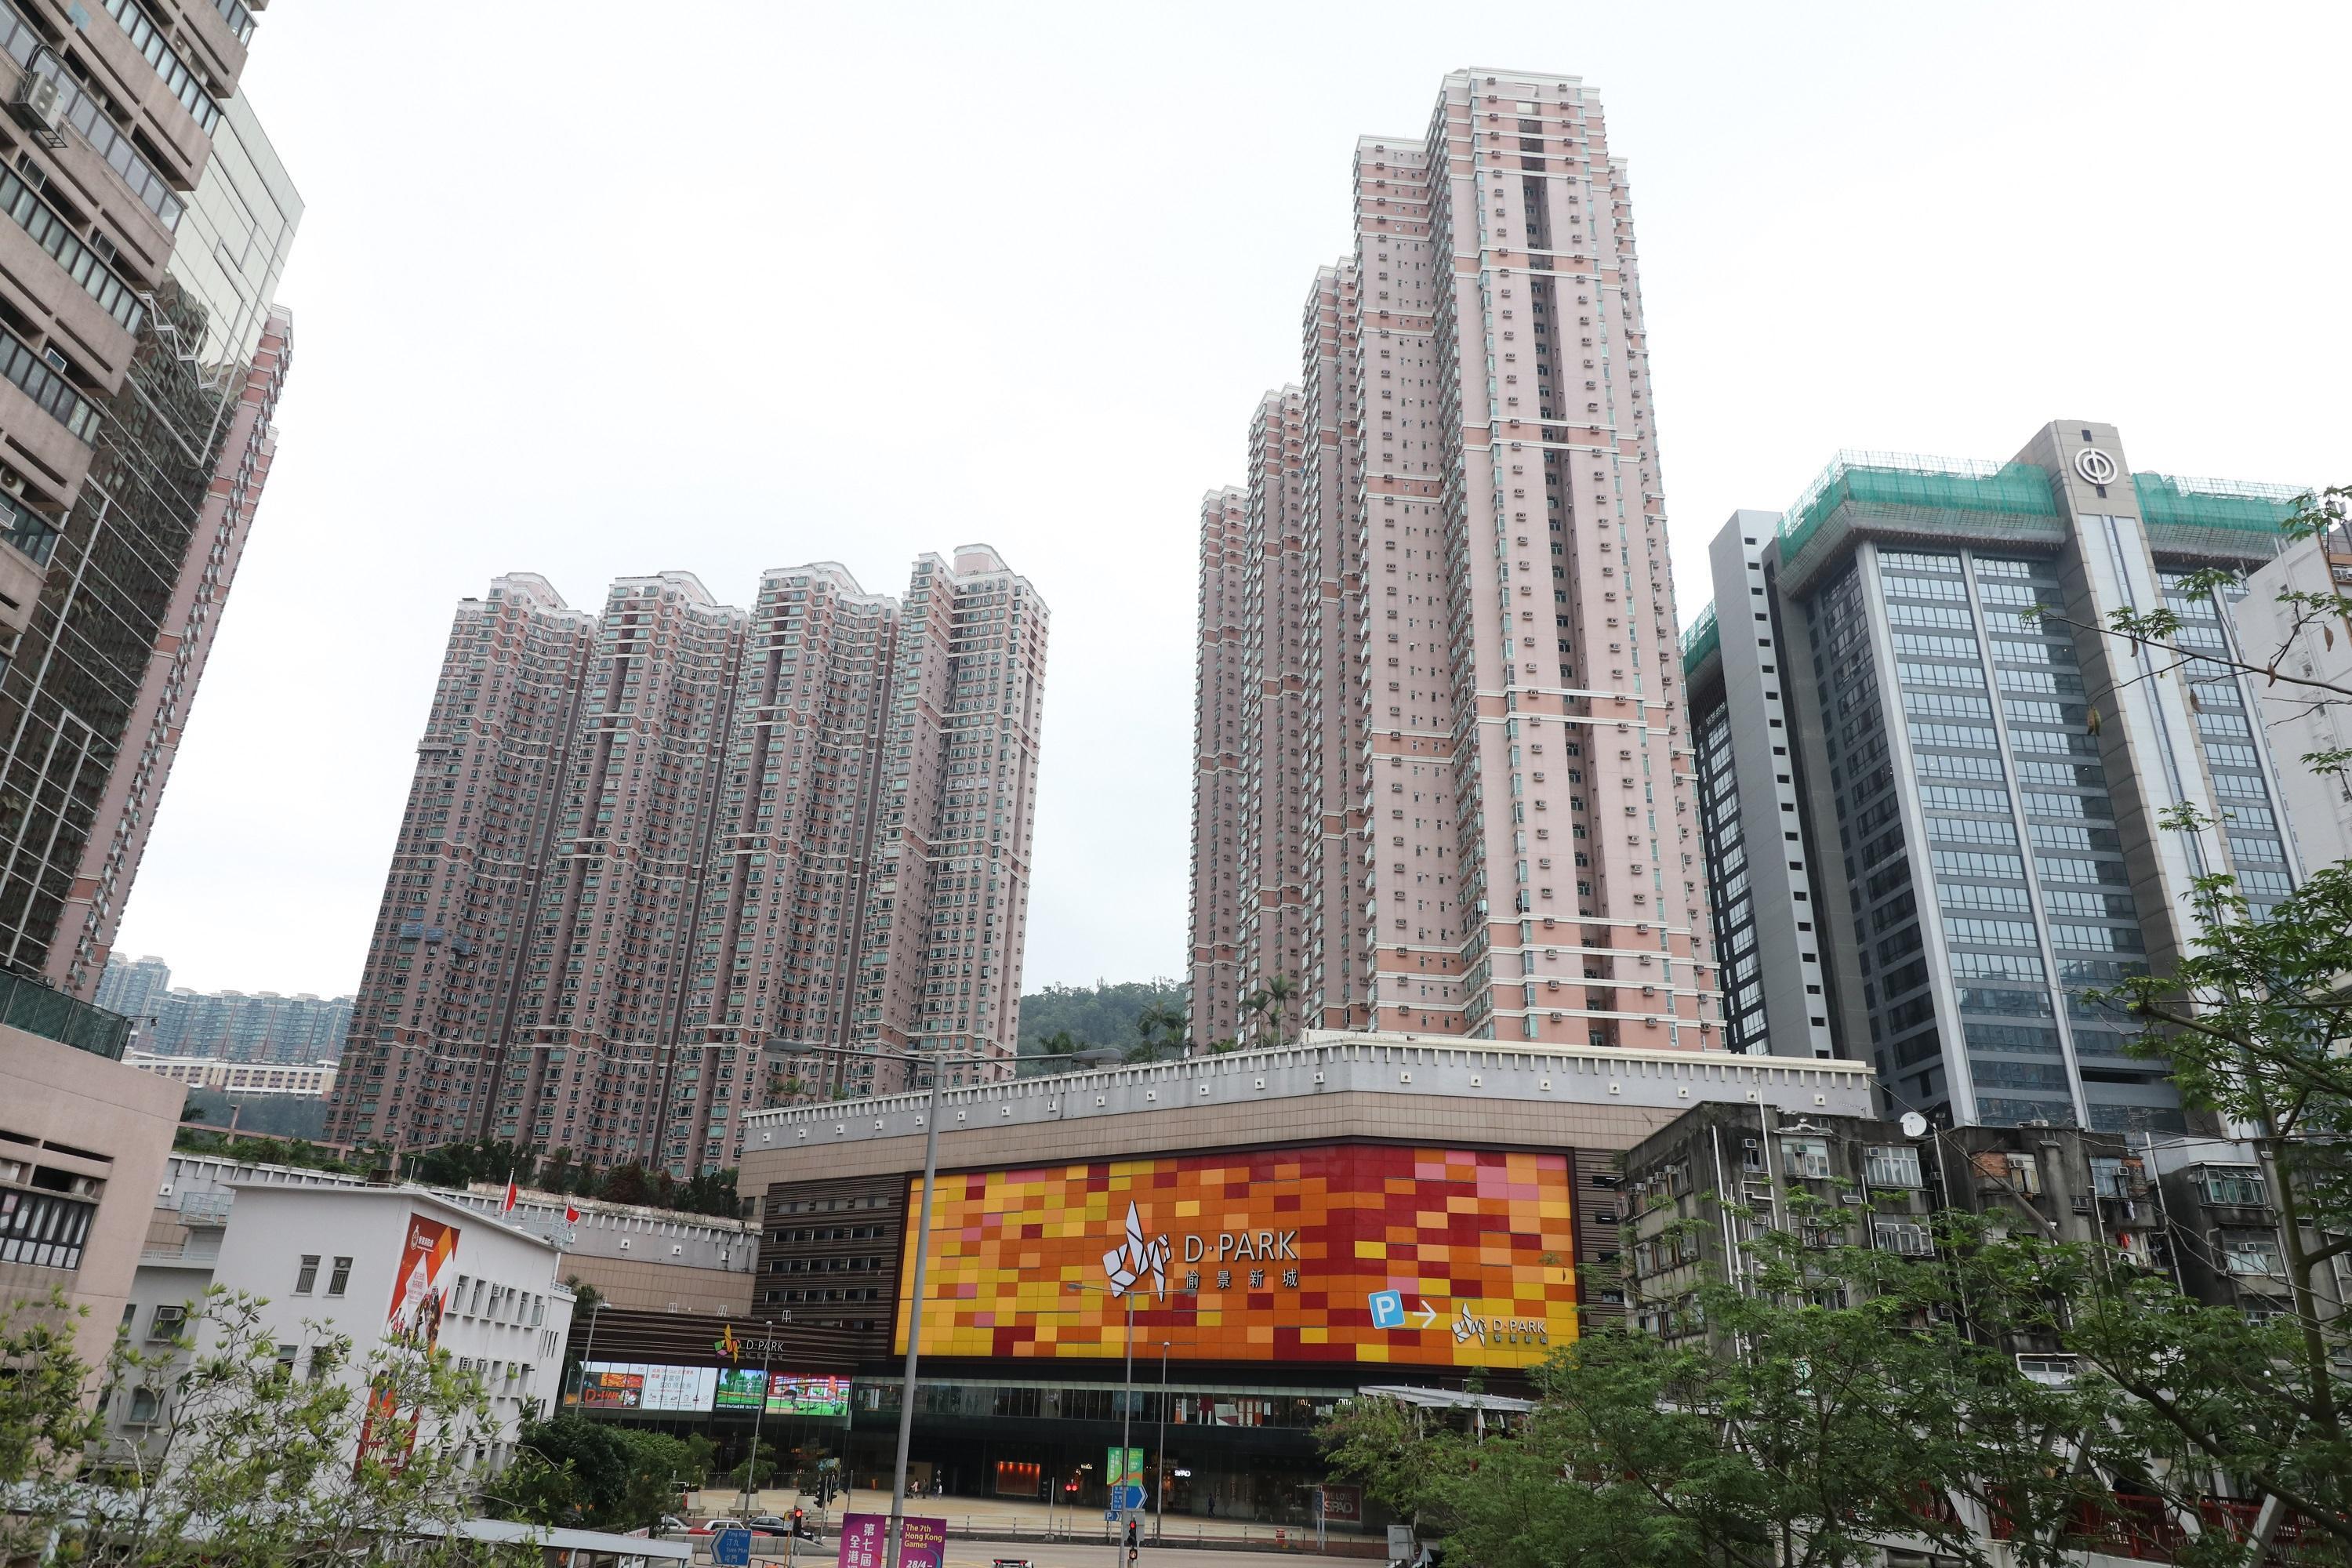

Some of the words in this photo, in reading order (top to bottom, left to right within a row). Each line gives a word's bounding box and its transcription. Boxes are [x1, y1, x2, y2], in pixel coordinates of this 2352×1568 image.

[1185, 1269, 1298, 1290] 愉景新城
[1376, 1296, 1395, 1323] P
[726, 1538, 739, 1547] 汀九
[905, 1533, 924, 1541] Hong
[925, 1534, 942, 1543] Kong
[724, 1554, 738, 1563] 屯門
[847, 1535, 861, 1568] 全港
